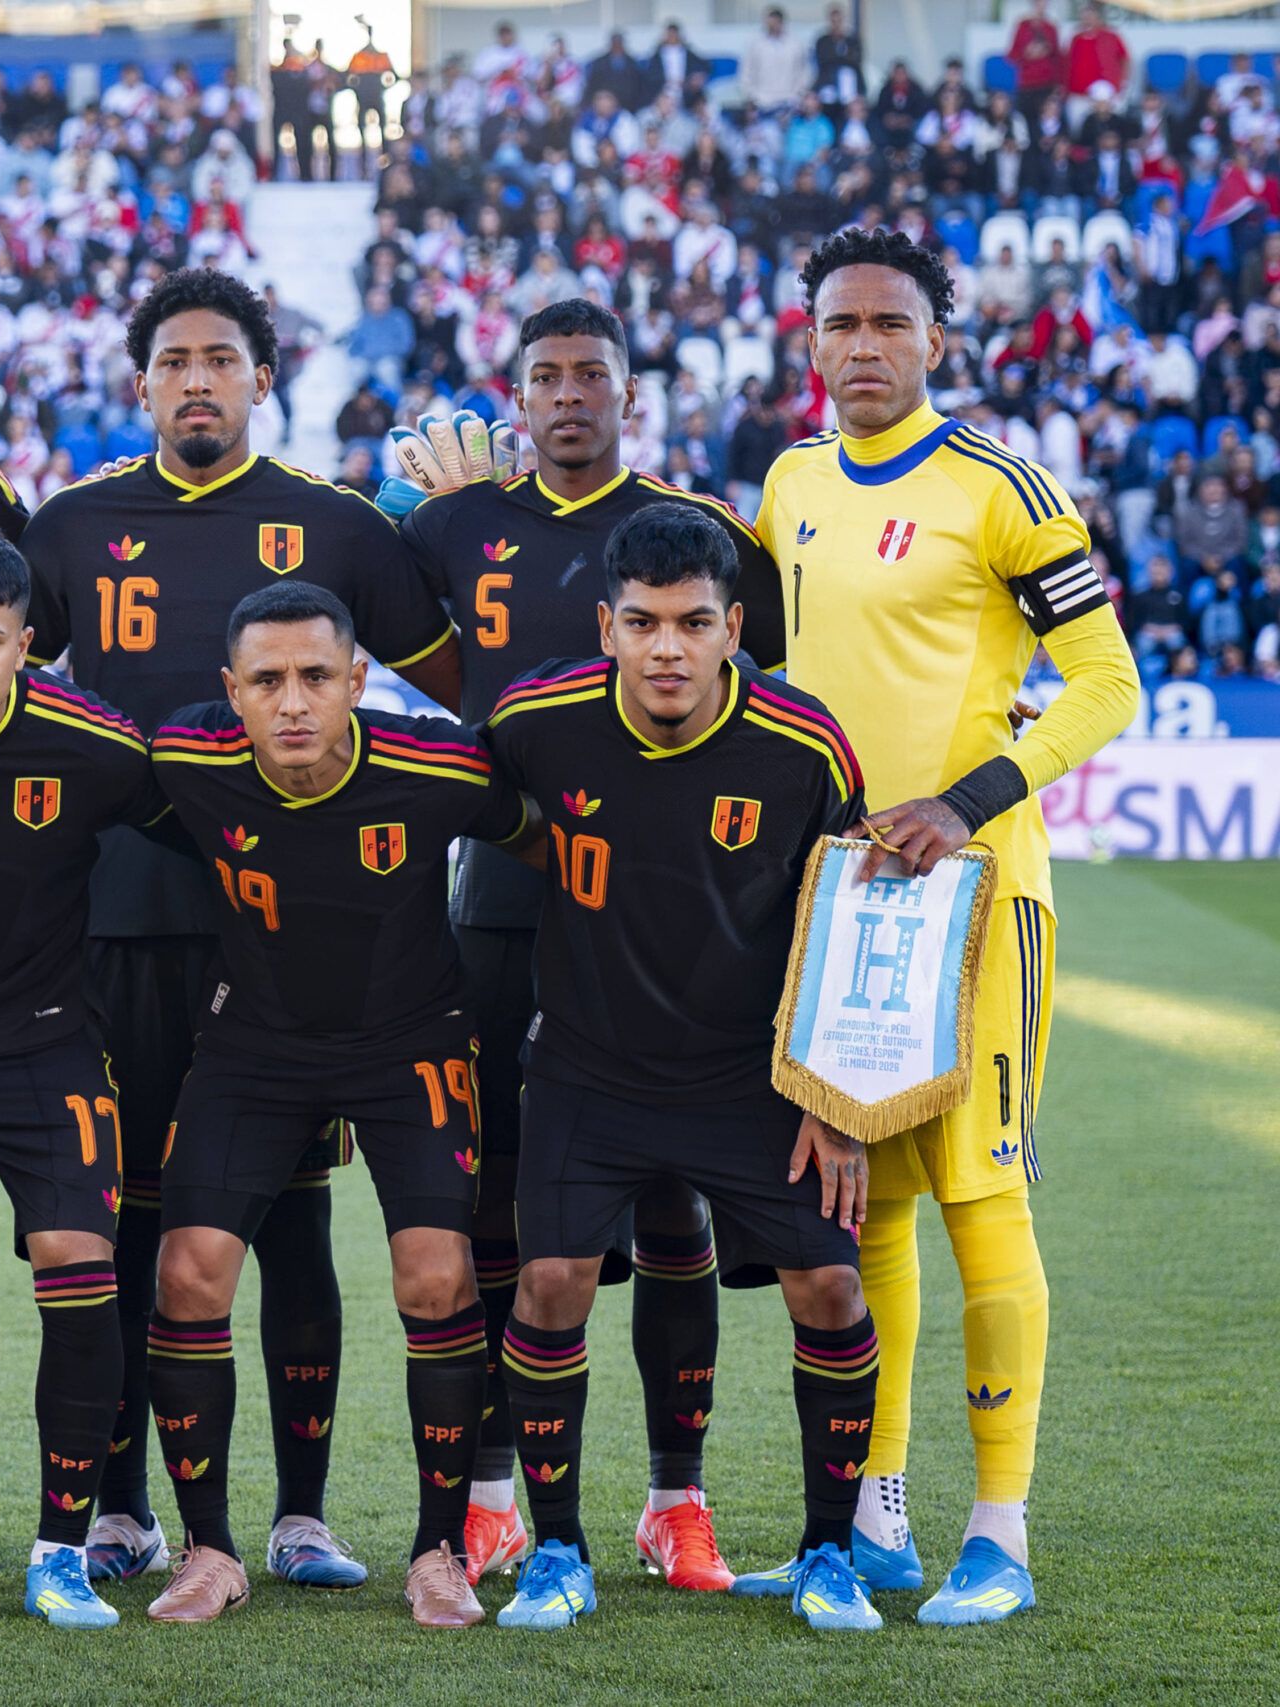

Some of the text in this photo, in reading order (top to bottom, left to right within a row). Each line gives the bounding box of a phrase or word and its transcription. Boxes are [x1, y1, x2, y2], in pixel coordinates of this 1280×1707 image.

[403, 447, 436, 490] ELITE
[883, 533, 910, 545] FPF
[475, 573, 513, 648] 5
[794, 563, 802, 637] 1
[96, 576, 159, 652] 16
[720, 815, 751, 826] FPF
[368, 841, 398, 852] FPF
[551, 822, 610, 910] 10
[215, 857, 278, 932] 19
[864, 876, 925, 906] FFH
[856, 923, 872, 994] HONDURAS
[850, 1059, 877, 1071] MARZO
[879, 1061, 900, 1073] 2026
[414, 1058, 477, 1135] 19
[993, 1053, 1011, 1128] 1
[65, 1095, 122, 1174] 17
[284, 1366, 330, 1381] FPF
[678, 1368, 714, 1383] FPF
[156, 1414, 198, 1431] FPF
[424, 1424, 463, 1443] FPF
[524, 1419, 565, 1435] FPF
[831, 1418, 870, 1434] FPF
[50, 1452, 93, 1471] FPF
